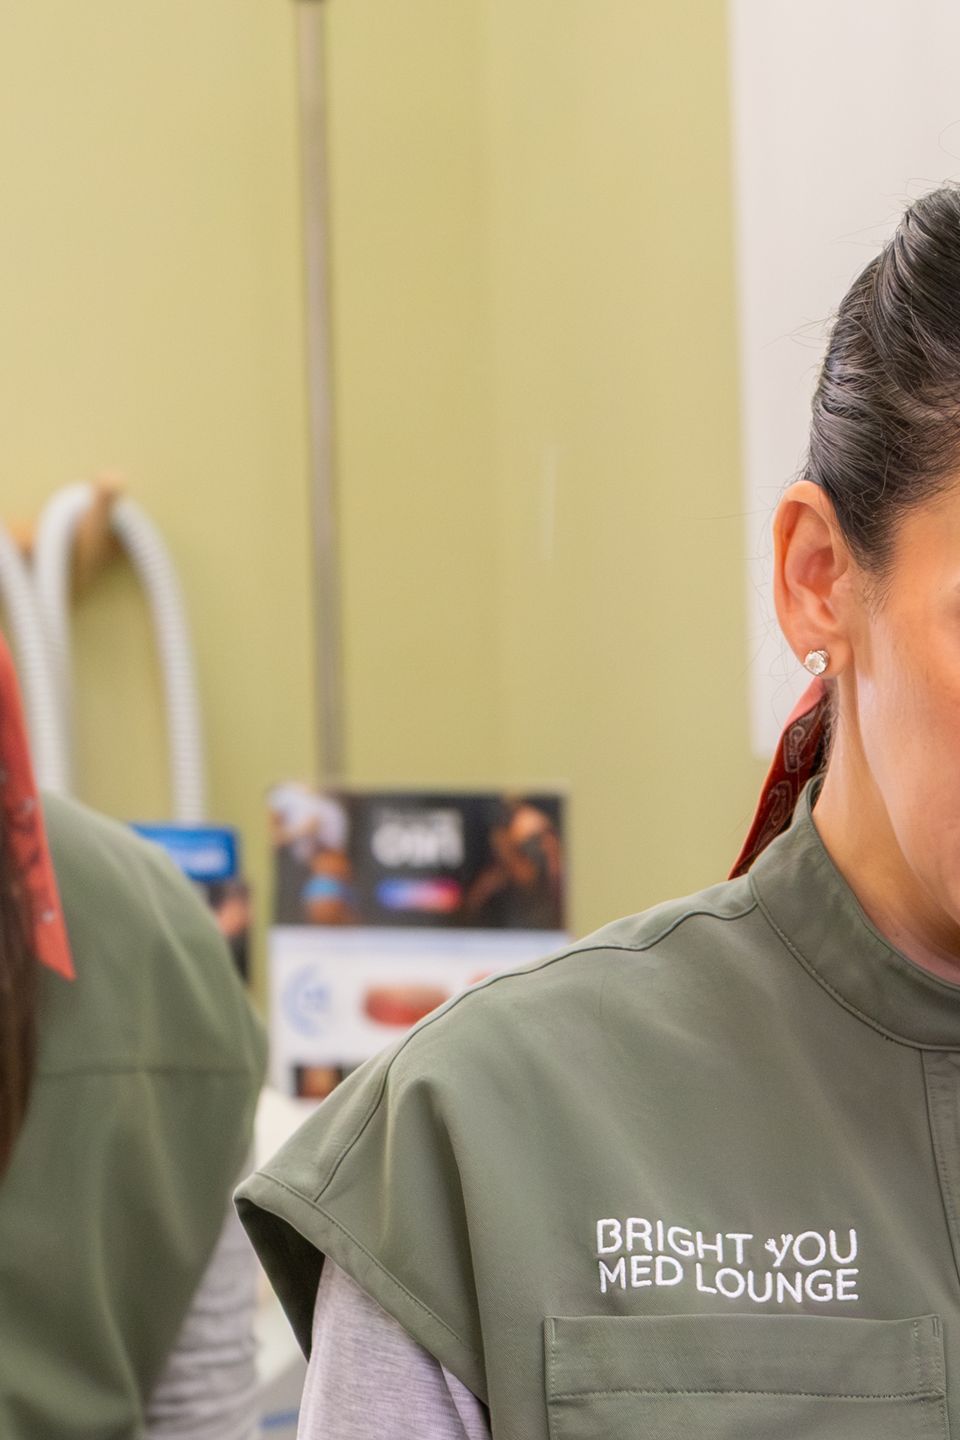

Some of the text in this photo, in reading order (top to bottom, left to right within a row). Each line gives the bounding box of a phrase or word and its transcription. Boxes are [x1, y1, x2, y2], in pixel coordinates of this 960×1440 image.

[597, 1217, 858, 1267] BRIGHT YOU
[598, 1255, 859, 1303] MED LOUNGE
